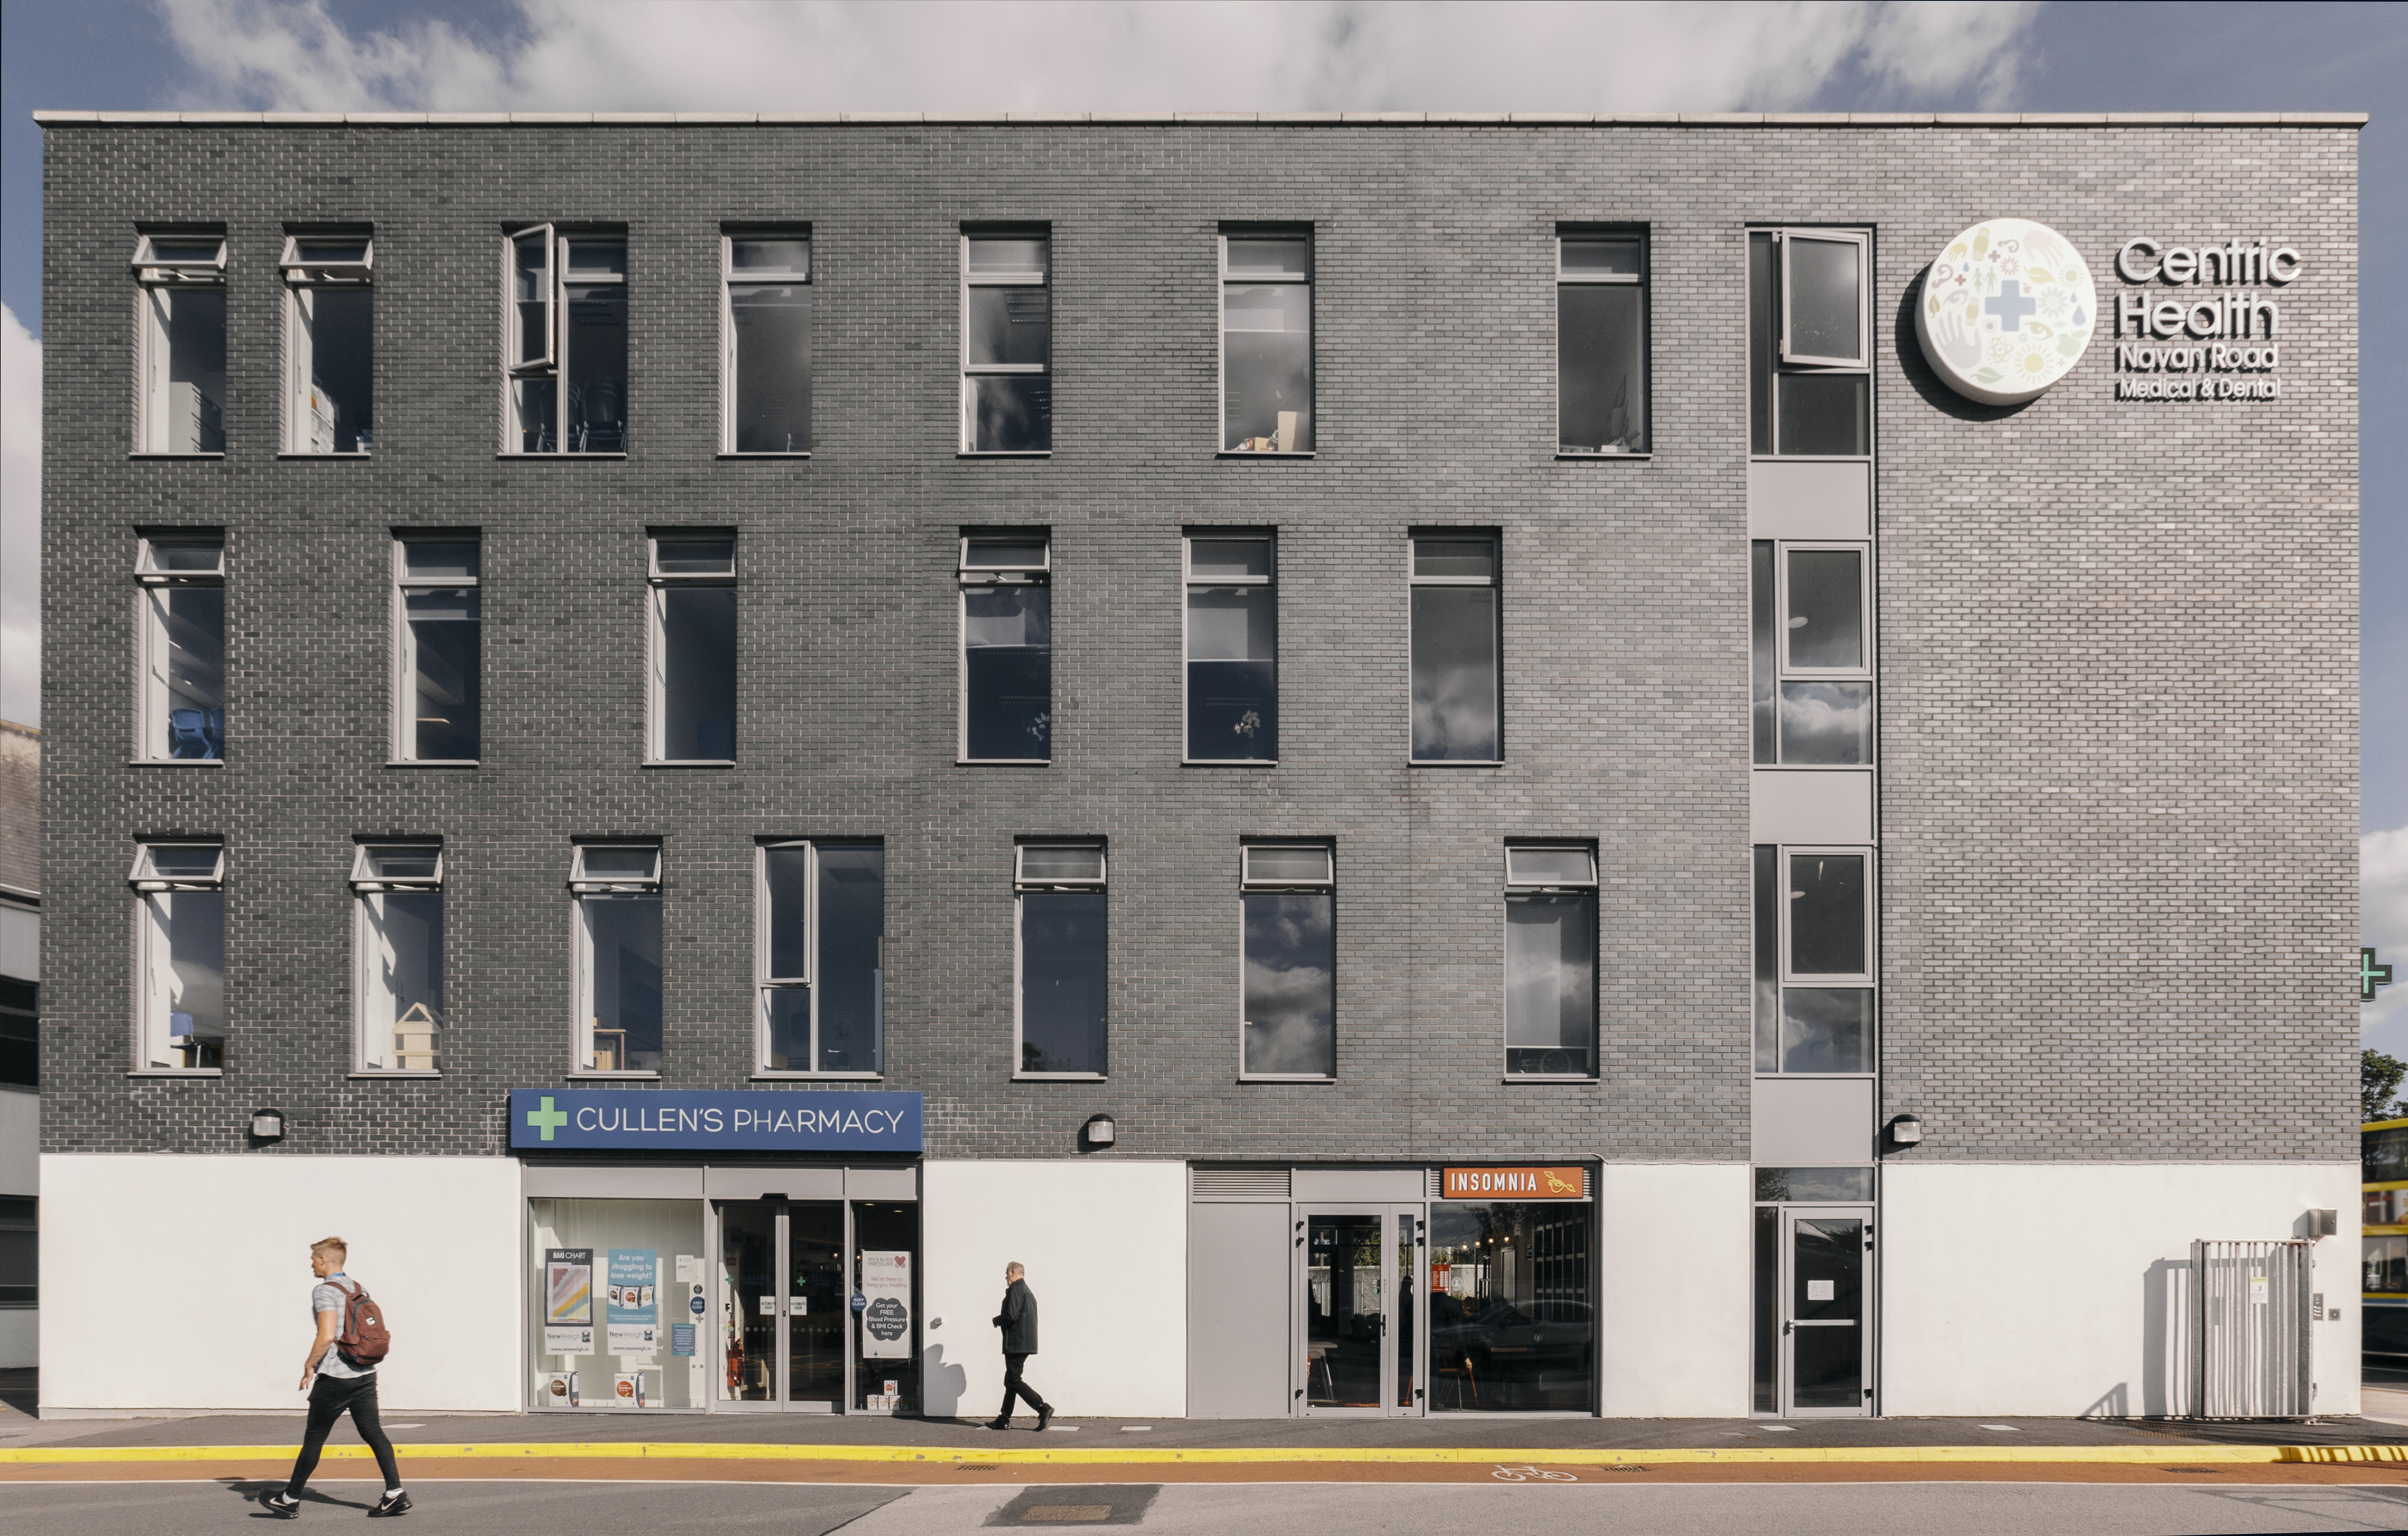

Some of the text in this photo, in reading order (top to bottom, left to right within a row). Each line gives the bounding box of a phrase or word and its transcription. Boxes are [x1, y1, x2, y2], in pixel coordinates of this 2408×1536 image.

[2119, 236, 2302, 282] Centric
[2119, 291, 2279, 336] Health
[2120, 342, 2279, 369] Navan Road
[2120, 378, 2281, 398] Medical & Dental
[577, 1107, 904, 1134] CULLEN'S PHARMACY
[1451, 1173, 1537, 1191] INSOMNIA
[611, 1263, 644, 1271] struggling
